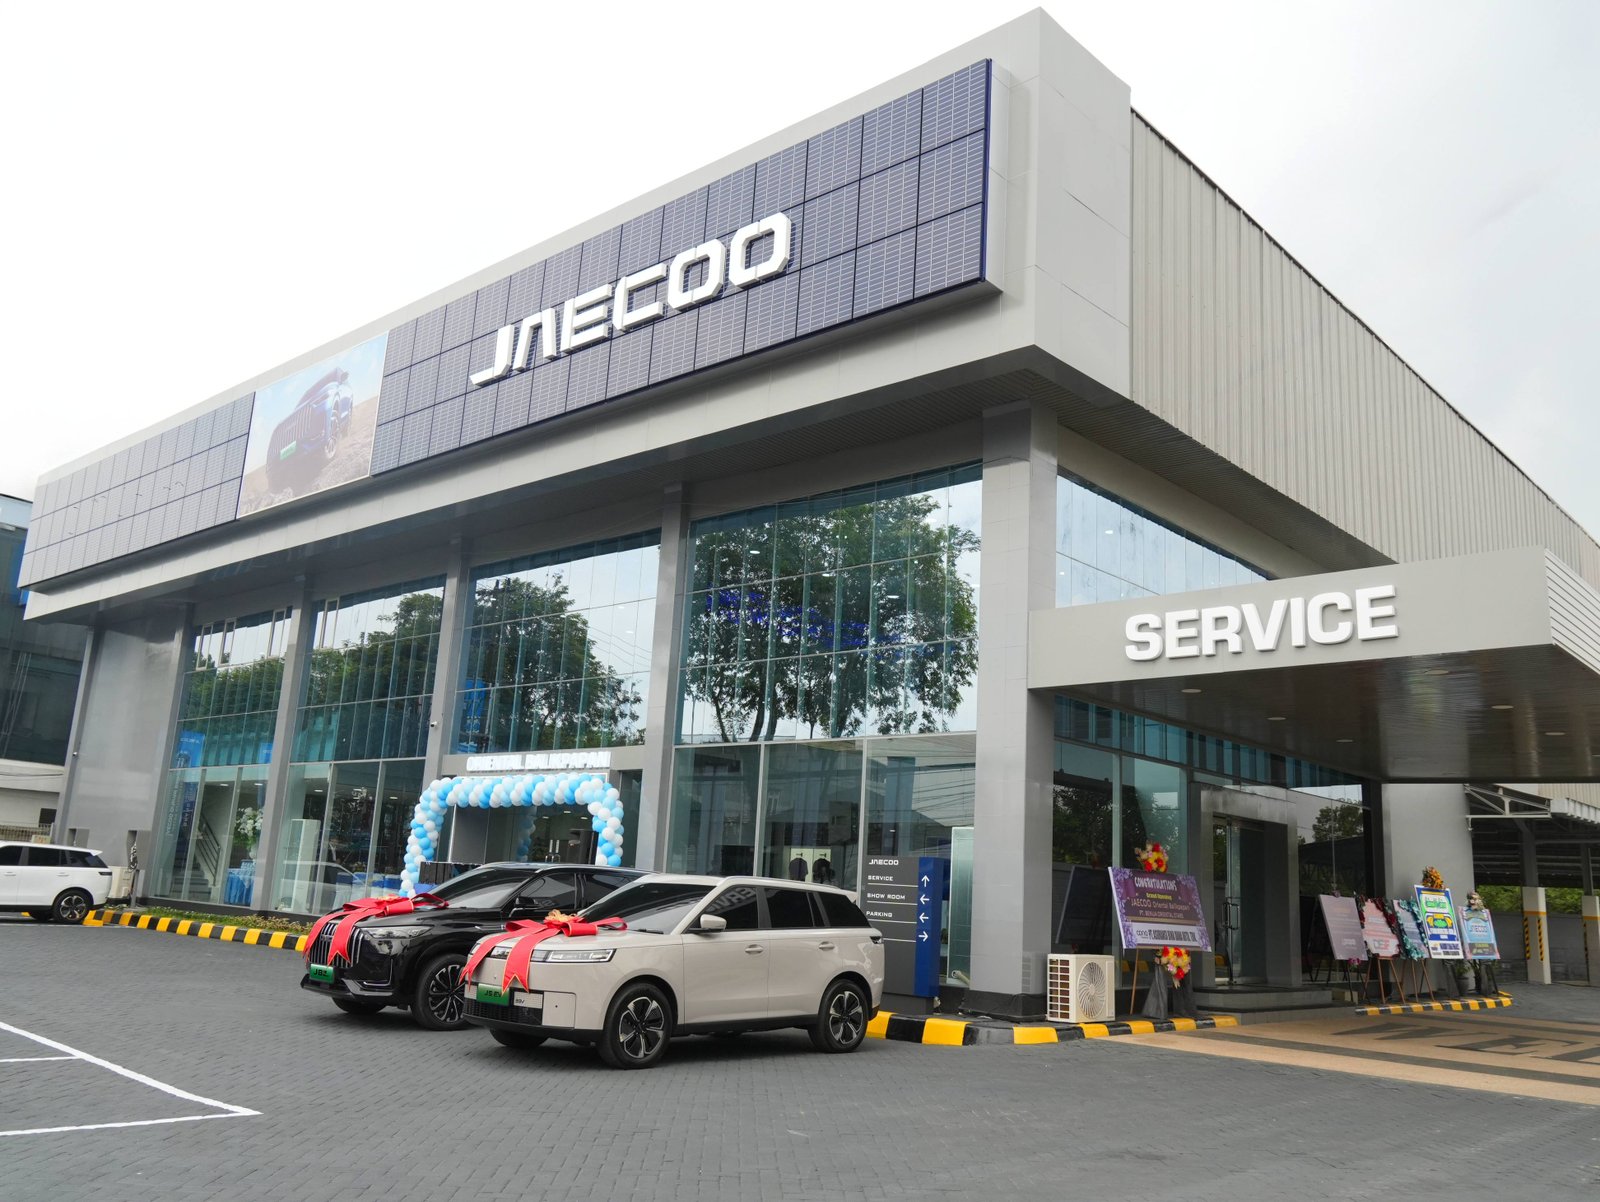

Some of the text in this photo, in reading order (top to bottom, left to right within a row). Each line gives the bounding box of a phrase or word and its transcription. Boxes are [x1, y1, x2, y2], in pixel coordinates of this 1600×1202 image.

[469, 211, 793, 387] JAECOO
[1125, 584, 1399, 661] SERVICE
[868, 858, 899, 866] JAECOO
[1134, 877, 1178, 891] CONGRATULATIONS
[1131, 898, 1152, 908] JAECOO
